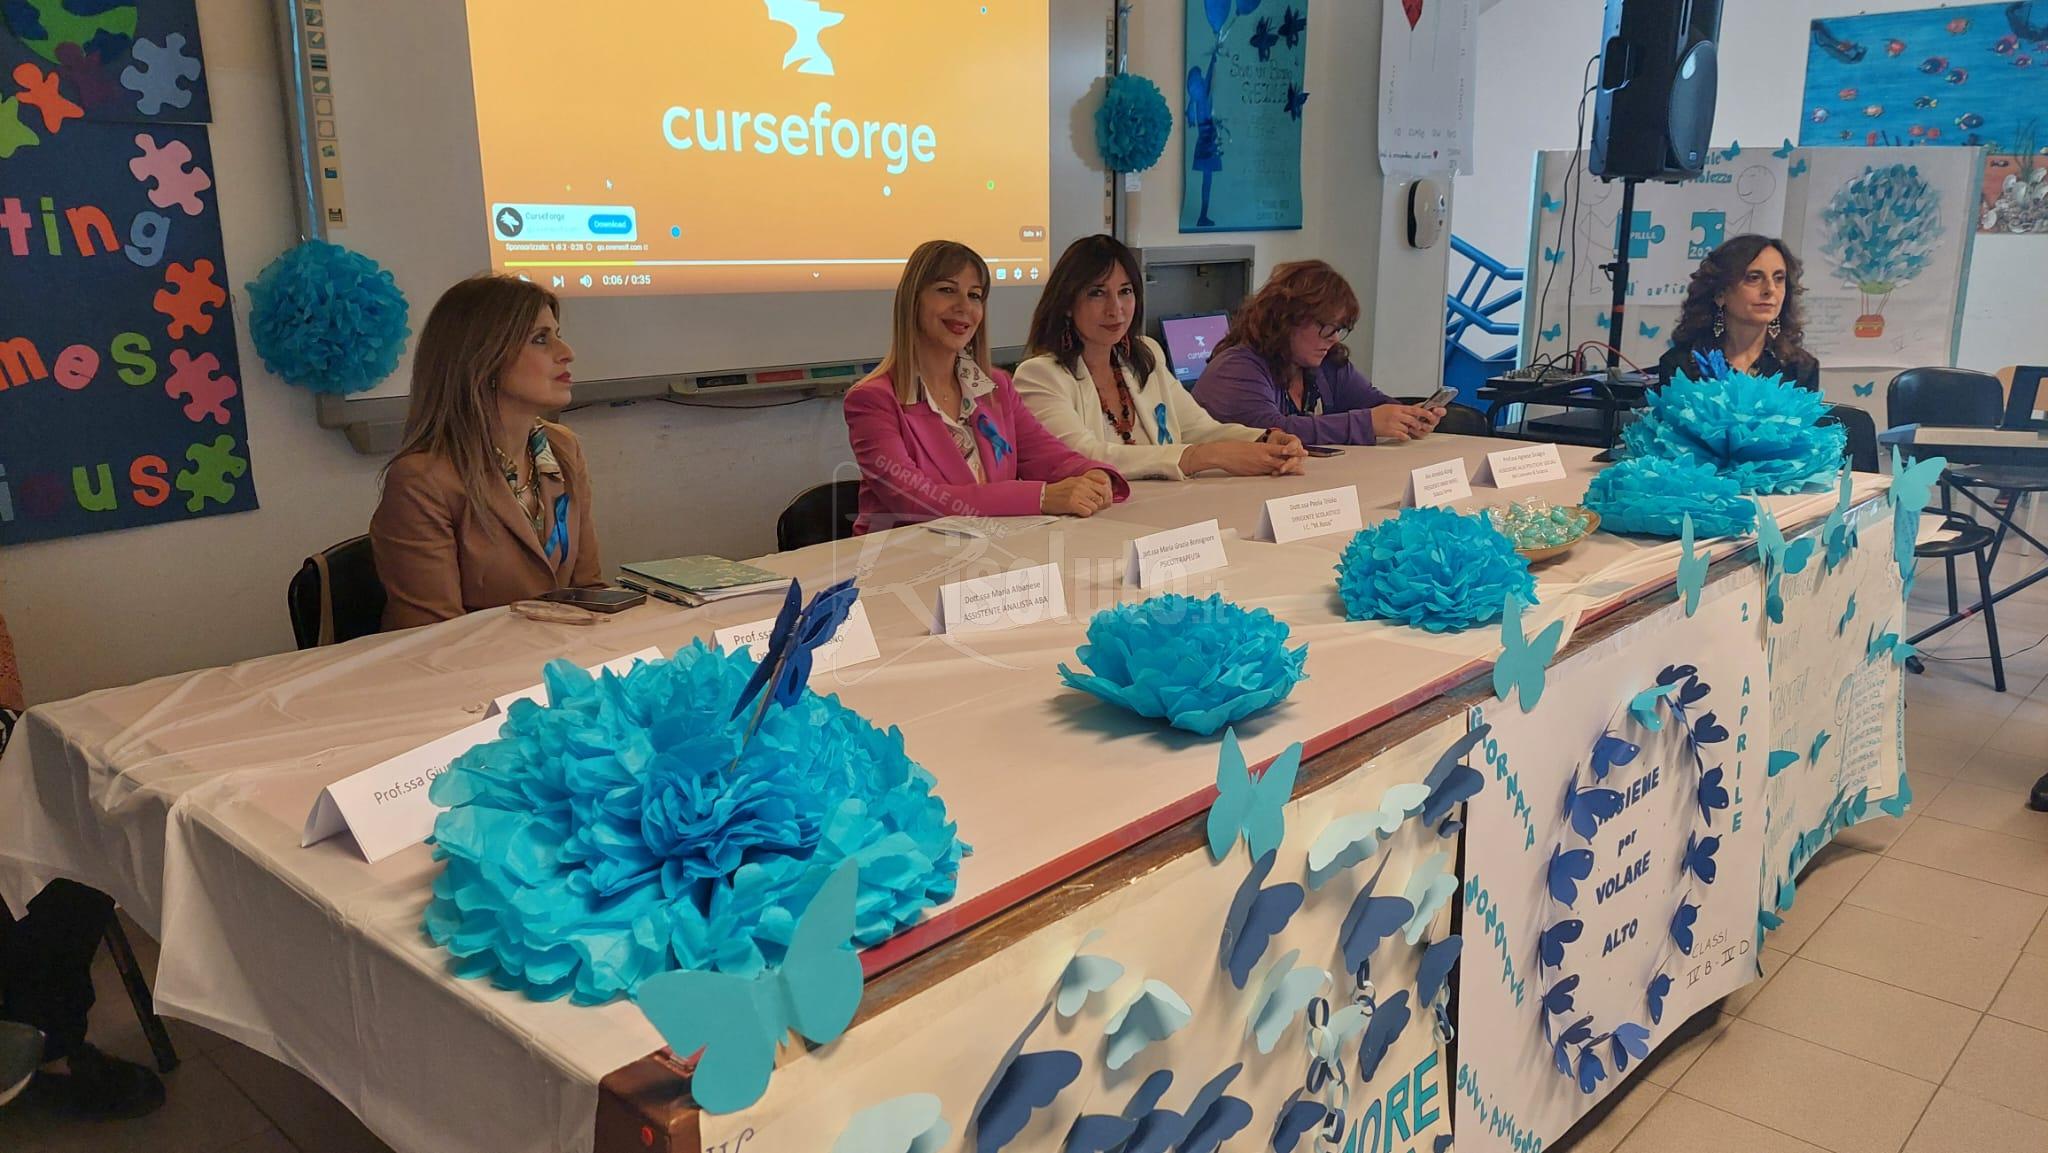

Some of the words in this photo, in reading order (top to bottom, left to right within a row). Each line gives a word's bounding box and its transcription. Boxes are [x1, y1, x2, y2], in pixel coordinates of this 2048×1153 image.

[662, 102, 937, 174] curseforge
[594, 220, 627, 229] Download
[1689, 246, 1713, 258] 202
[602, 275, 623, 286] 0:06
[631, 275, 651, 285] 0:35
[1647, 283, 1686, 296] autis
[1160, 543, 1174, 553] Maria
[991, 588, 1011, 598] Maria
[1011, 582, 1041, 593] Albanese
[963, 605, 1002, 621] ASSISTENTE
[1002, 599, 1034, 612] ANALISTA
[1741, 602, 1749, 622] 2
[1731, 675, 1751, 833] APRILE
[373, 776, 425, 805] Prof.ssa
[1617, 829, 1638, 857] per
[1595, 850, 1652, 905] VOLARE
[1464, 874, 1525, 1008] MONDIALE
[1601, 918, 1638, 957] ALTO
[1690, 929, 1729, 960] CLASSI
[1739, 939, 1751, 956] D
